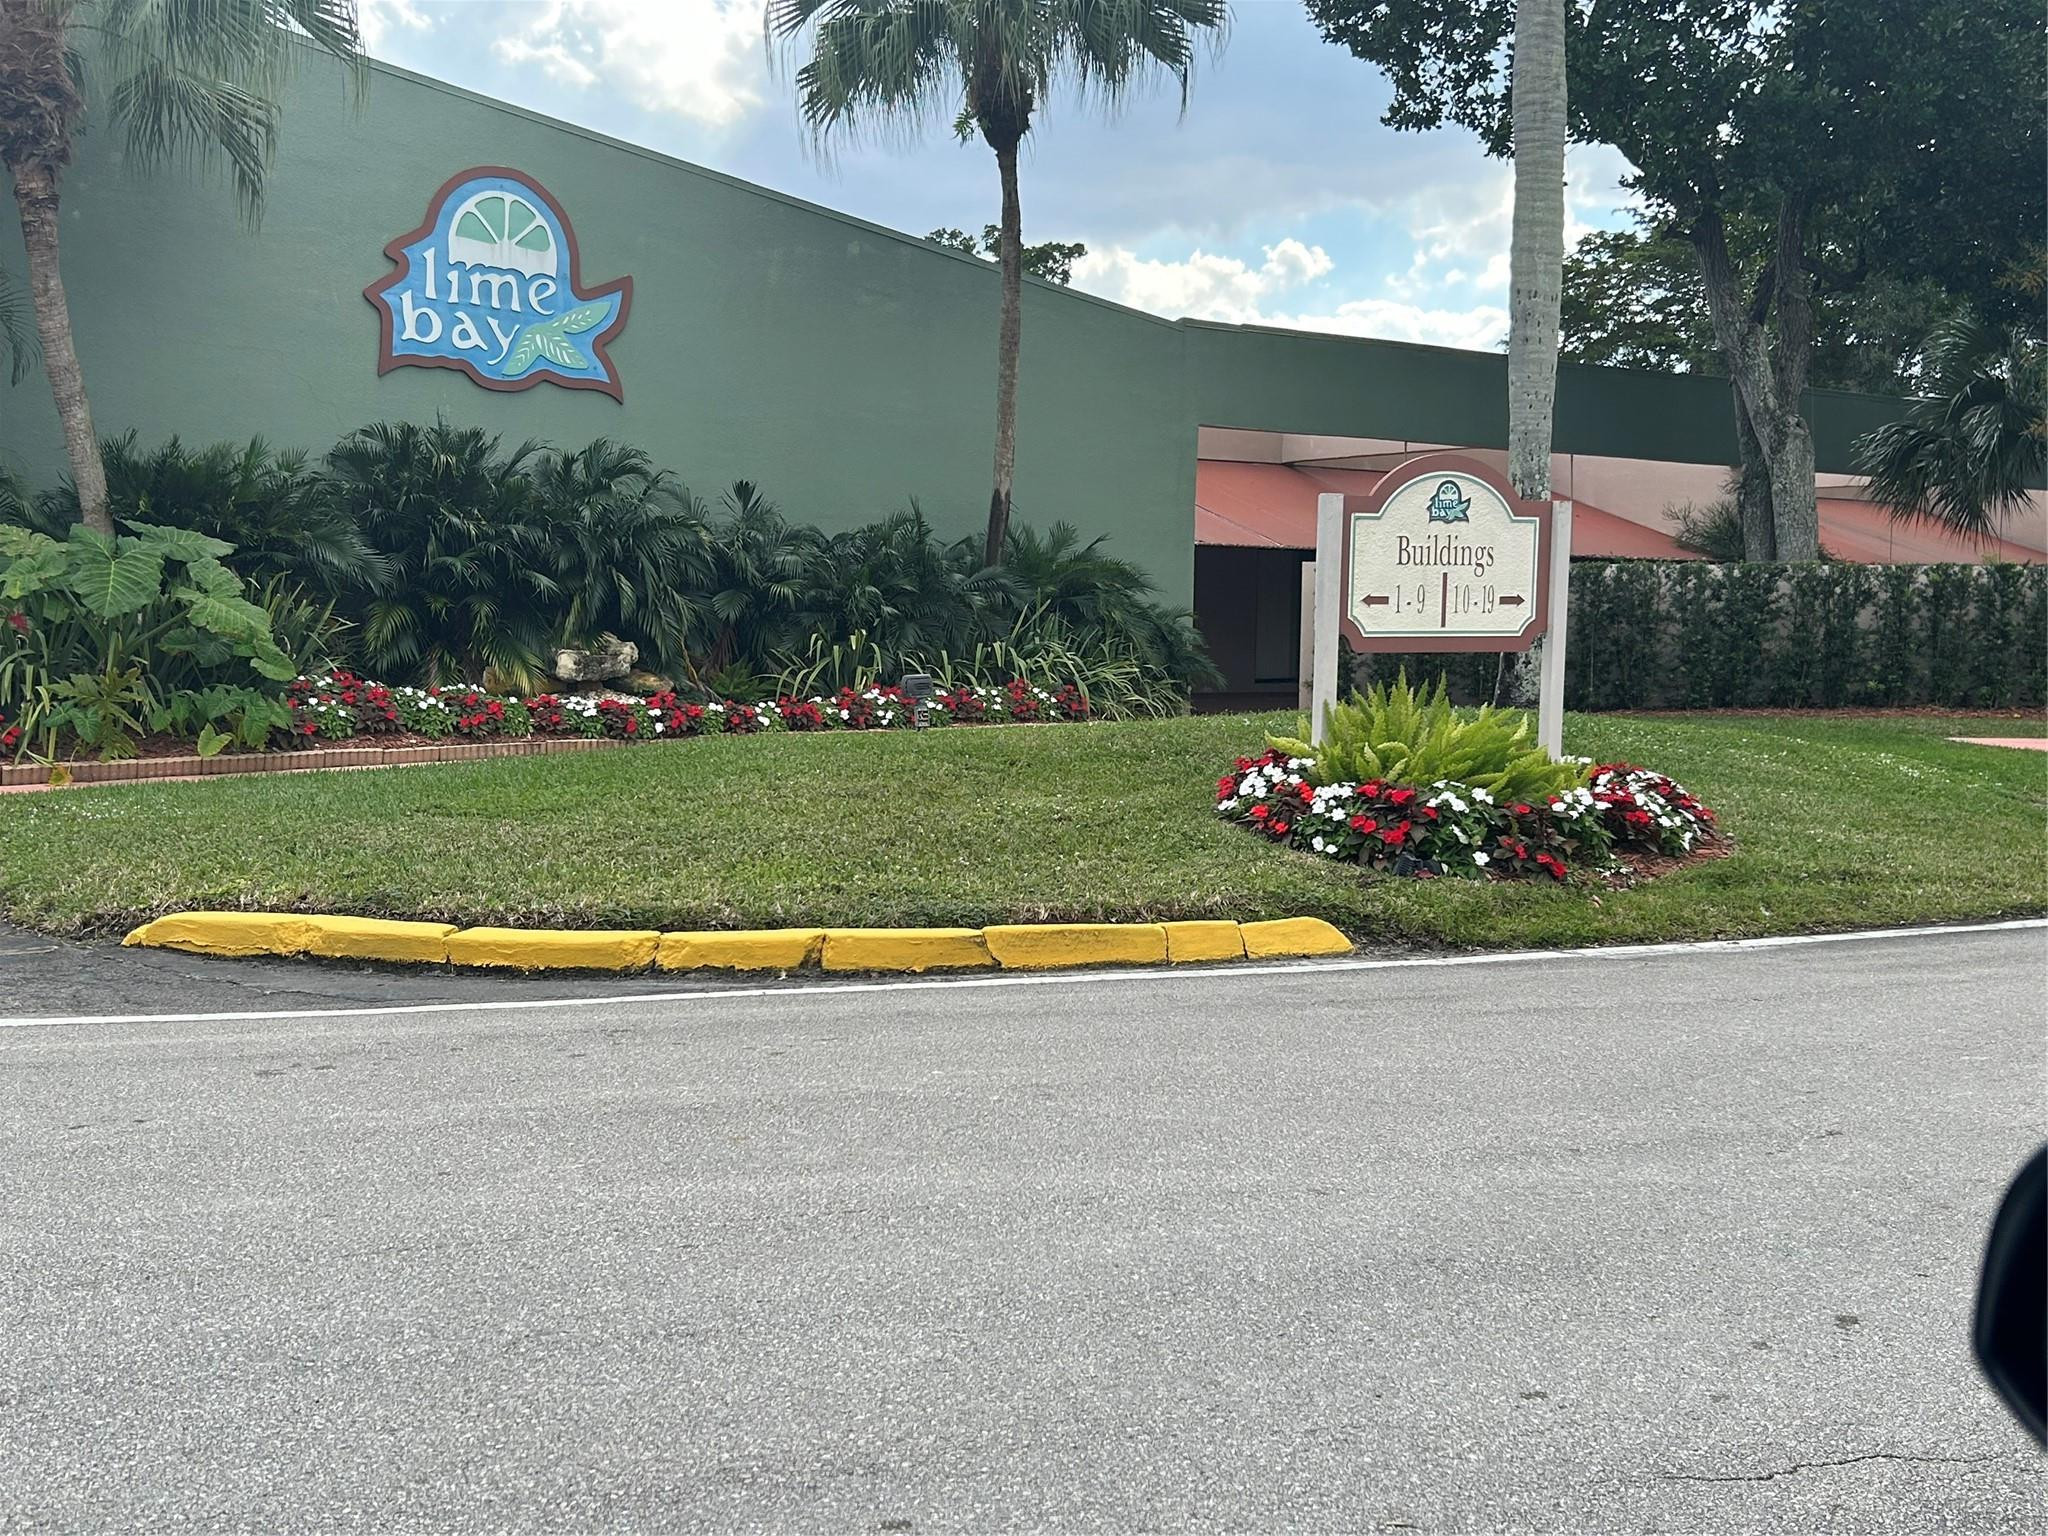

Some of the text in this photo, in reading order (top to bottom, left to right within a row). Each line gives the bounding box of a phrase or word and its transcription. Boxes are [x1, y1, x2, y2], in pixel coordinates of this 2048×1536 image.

[423, 247, 557, 315] lime
[401, 290, 520, 365] bay
[1434, 496, 1458, 508] lime
[1396, 535, 1494, 577] Buildings
[1454, 584, 1495, 614] 10-19
